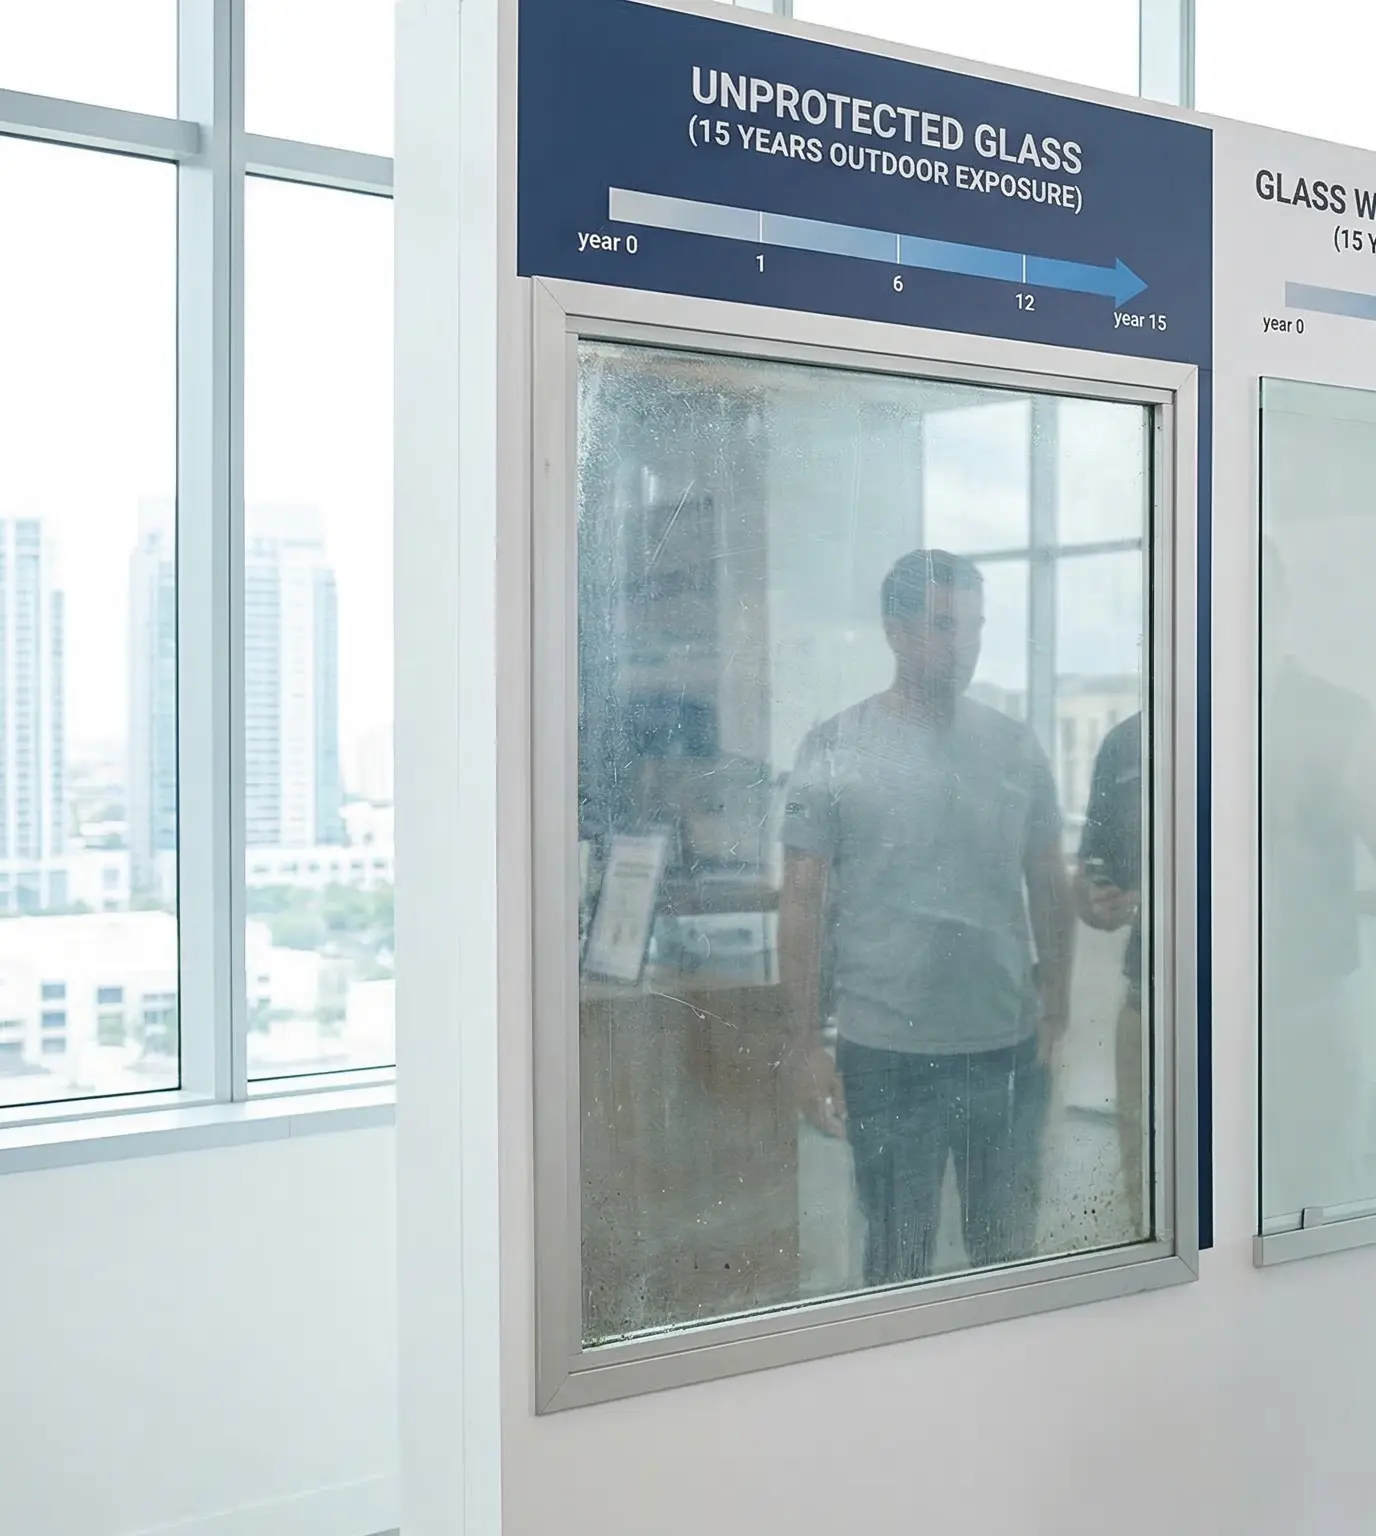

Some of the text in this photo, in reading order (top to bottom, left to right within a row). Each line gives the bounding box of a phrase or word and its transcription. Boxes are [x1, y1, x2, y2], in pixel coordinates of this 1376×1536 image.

[691, 65, 1083, 176] UNPROTECTED GLASS
[688, 113, 1084, 216] (15 YEARS OUTDOOR EXPOSURE)
[1255, 168, 1347, 215] GLASS
[577, 229, 639, 255] year 0
[1333, 224, 1364, 253] (15
[755, 253, 765, 274] 1
[893, 275, 904, 292] 6
[1014, 292, 1035, 312] 12
[1112, 309, 1167, 332] year 15
[1262, 315, 1305, 335] year 0
